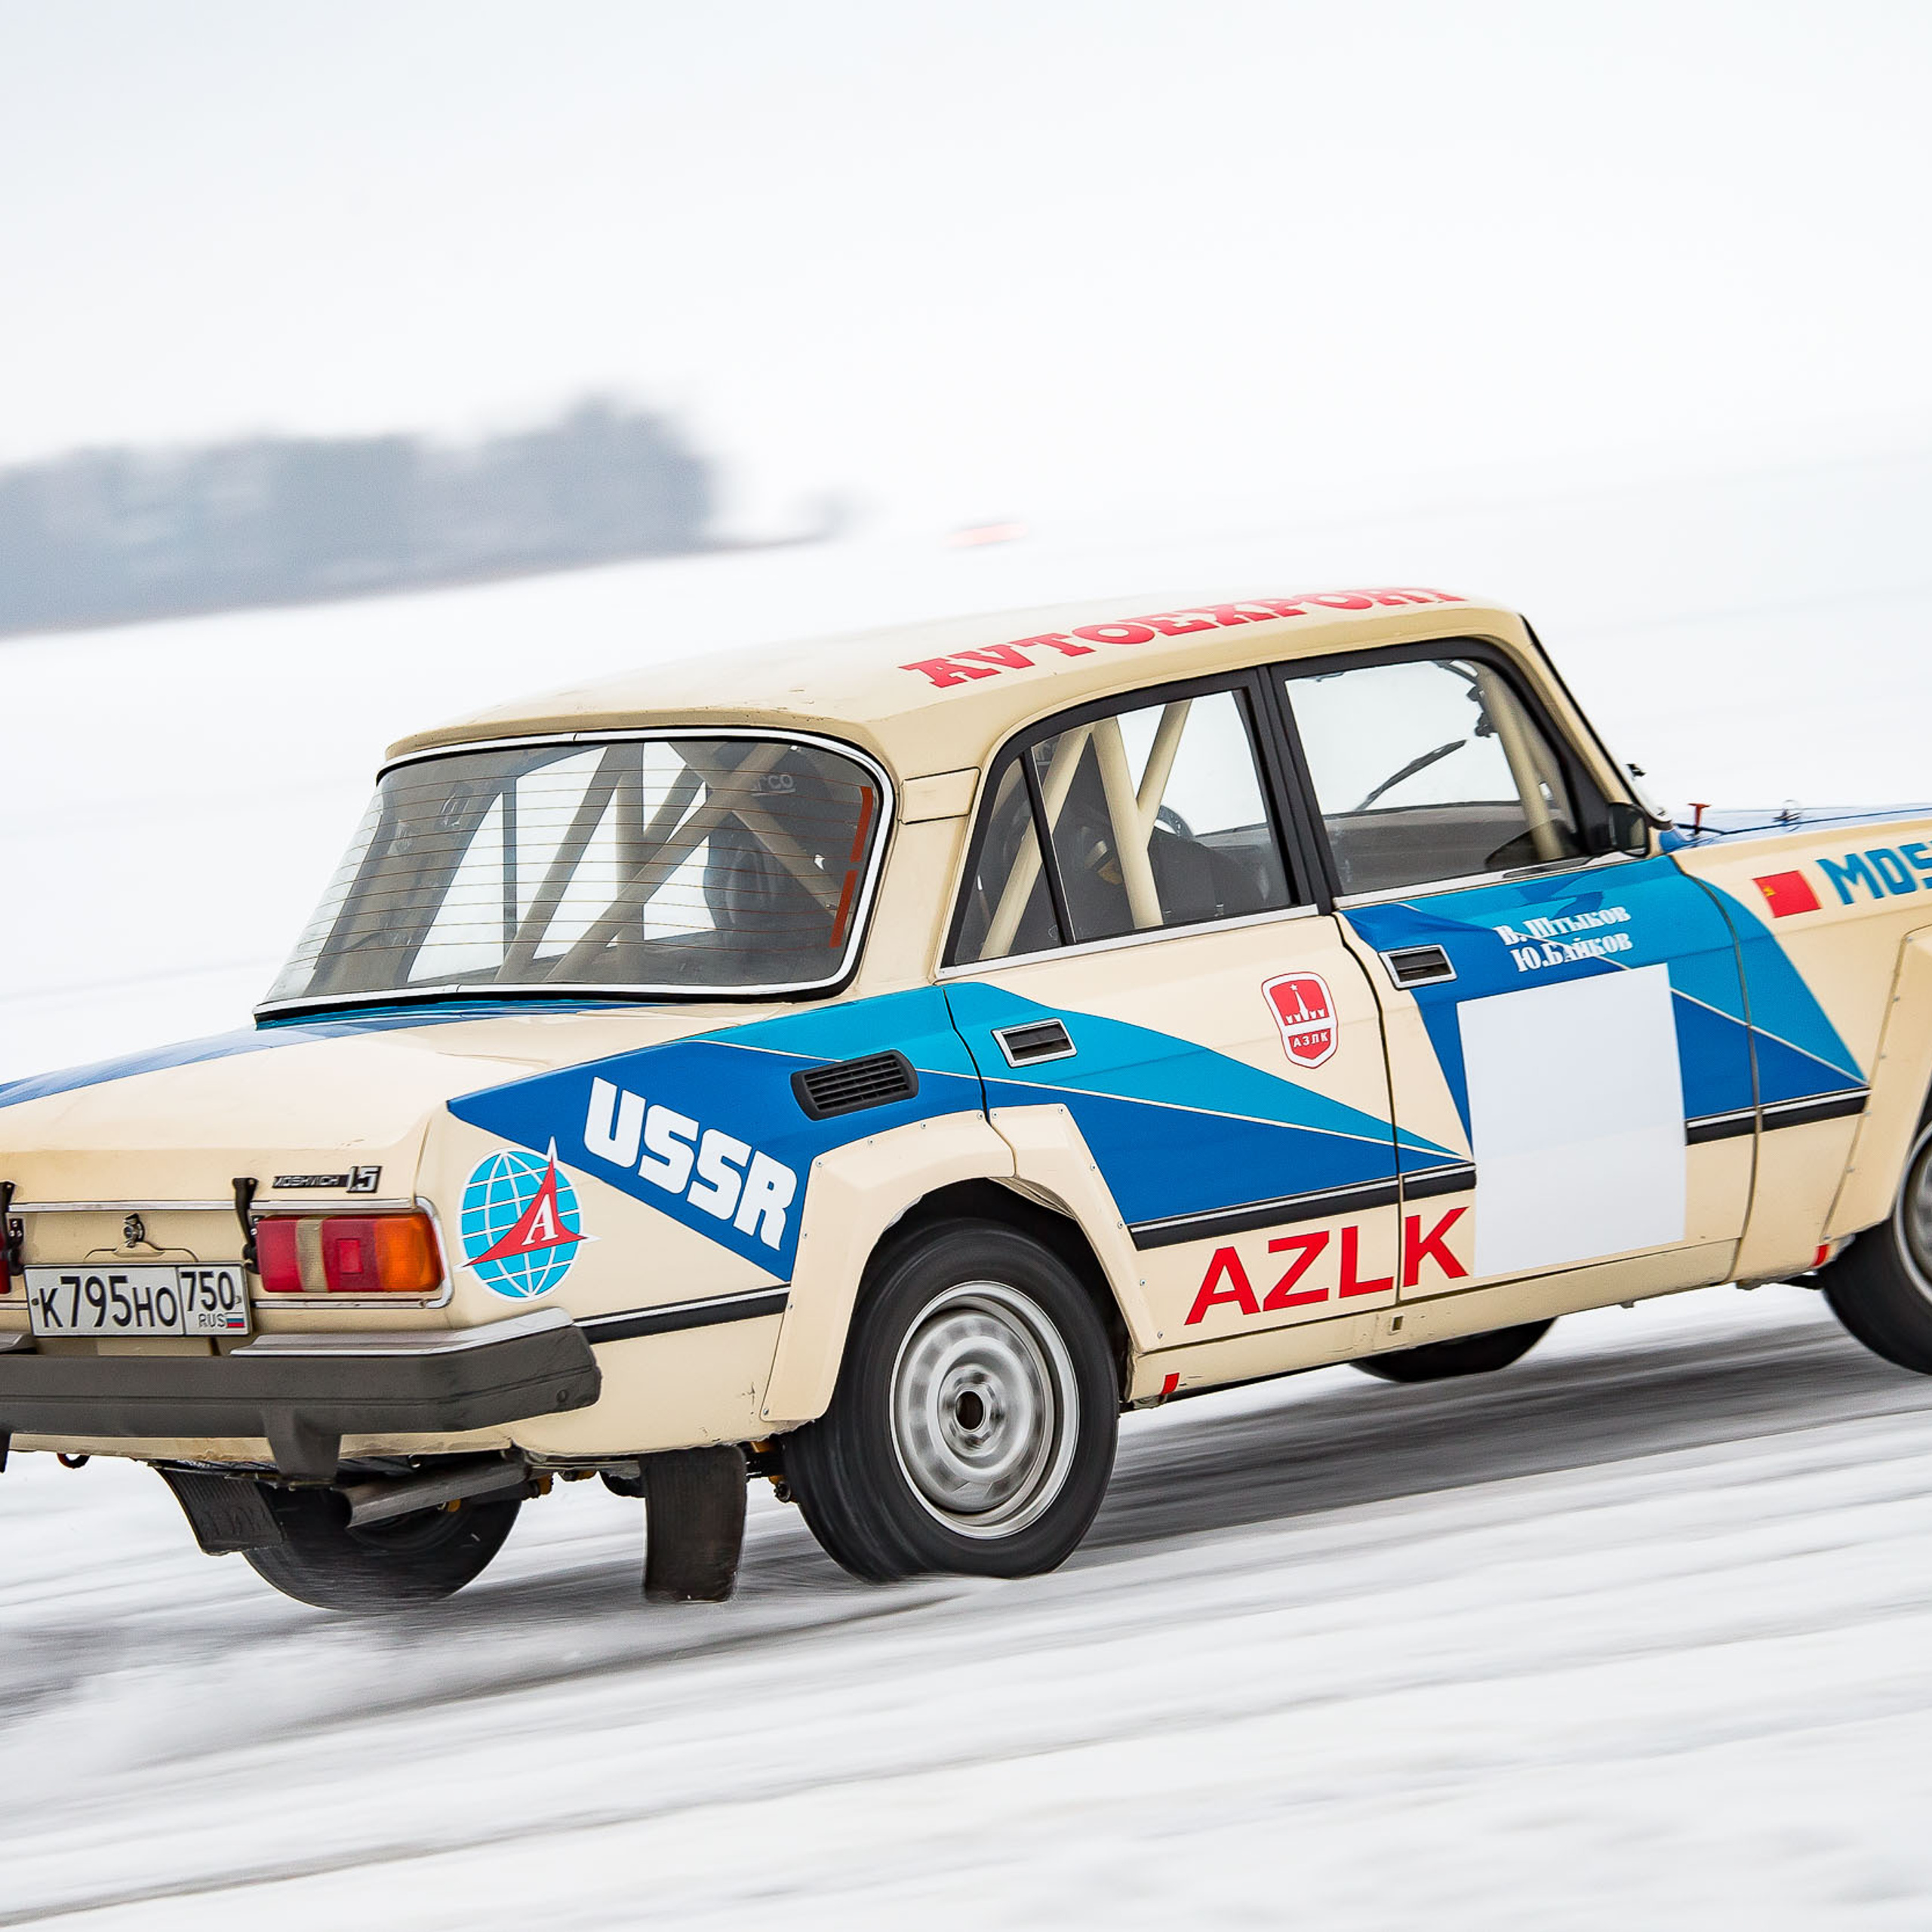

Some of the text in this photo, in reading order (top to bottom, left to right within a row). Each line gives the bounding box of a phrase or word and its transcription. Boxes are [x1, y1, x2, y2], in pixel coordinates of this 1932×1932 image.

[900, 587, 1468, 688] AVTOEXPORT
[1815, 840, 1932, 905] MOS
[1493, 906, 1632, 946] В. Штыков
[1511, 933, 1634, 972] Ю.Байков
[1293, 1031, 1329, 1048] АЗЛК
[583, 1077, 797, 1251] USSR
[1184, 1206, 1469, 1326] AZLK
[180, 1271, 235, 1312] 750
[198, 1313, 226, 1327] RUS
